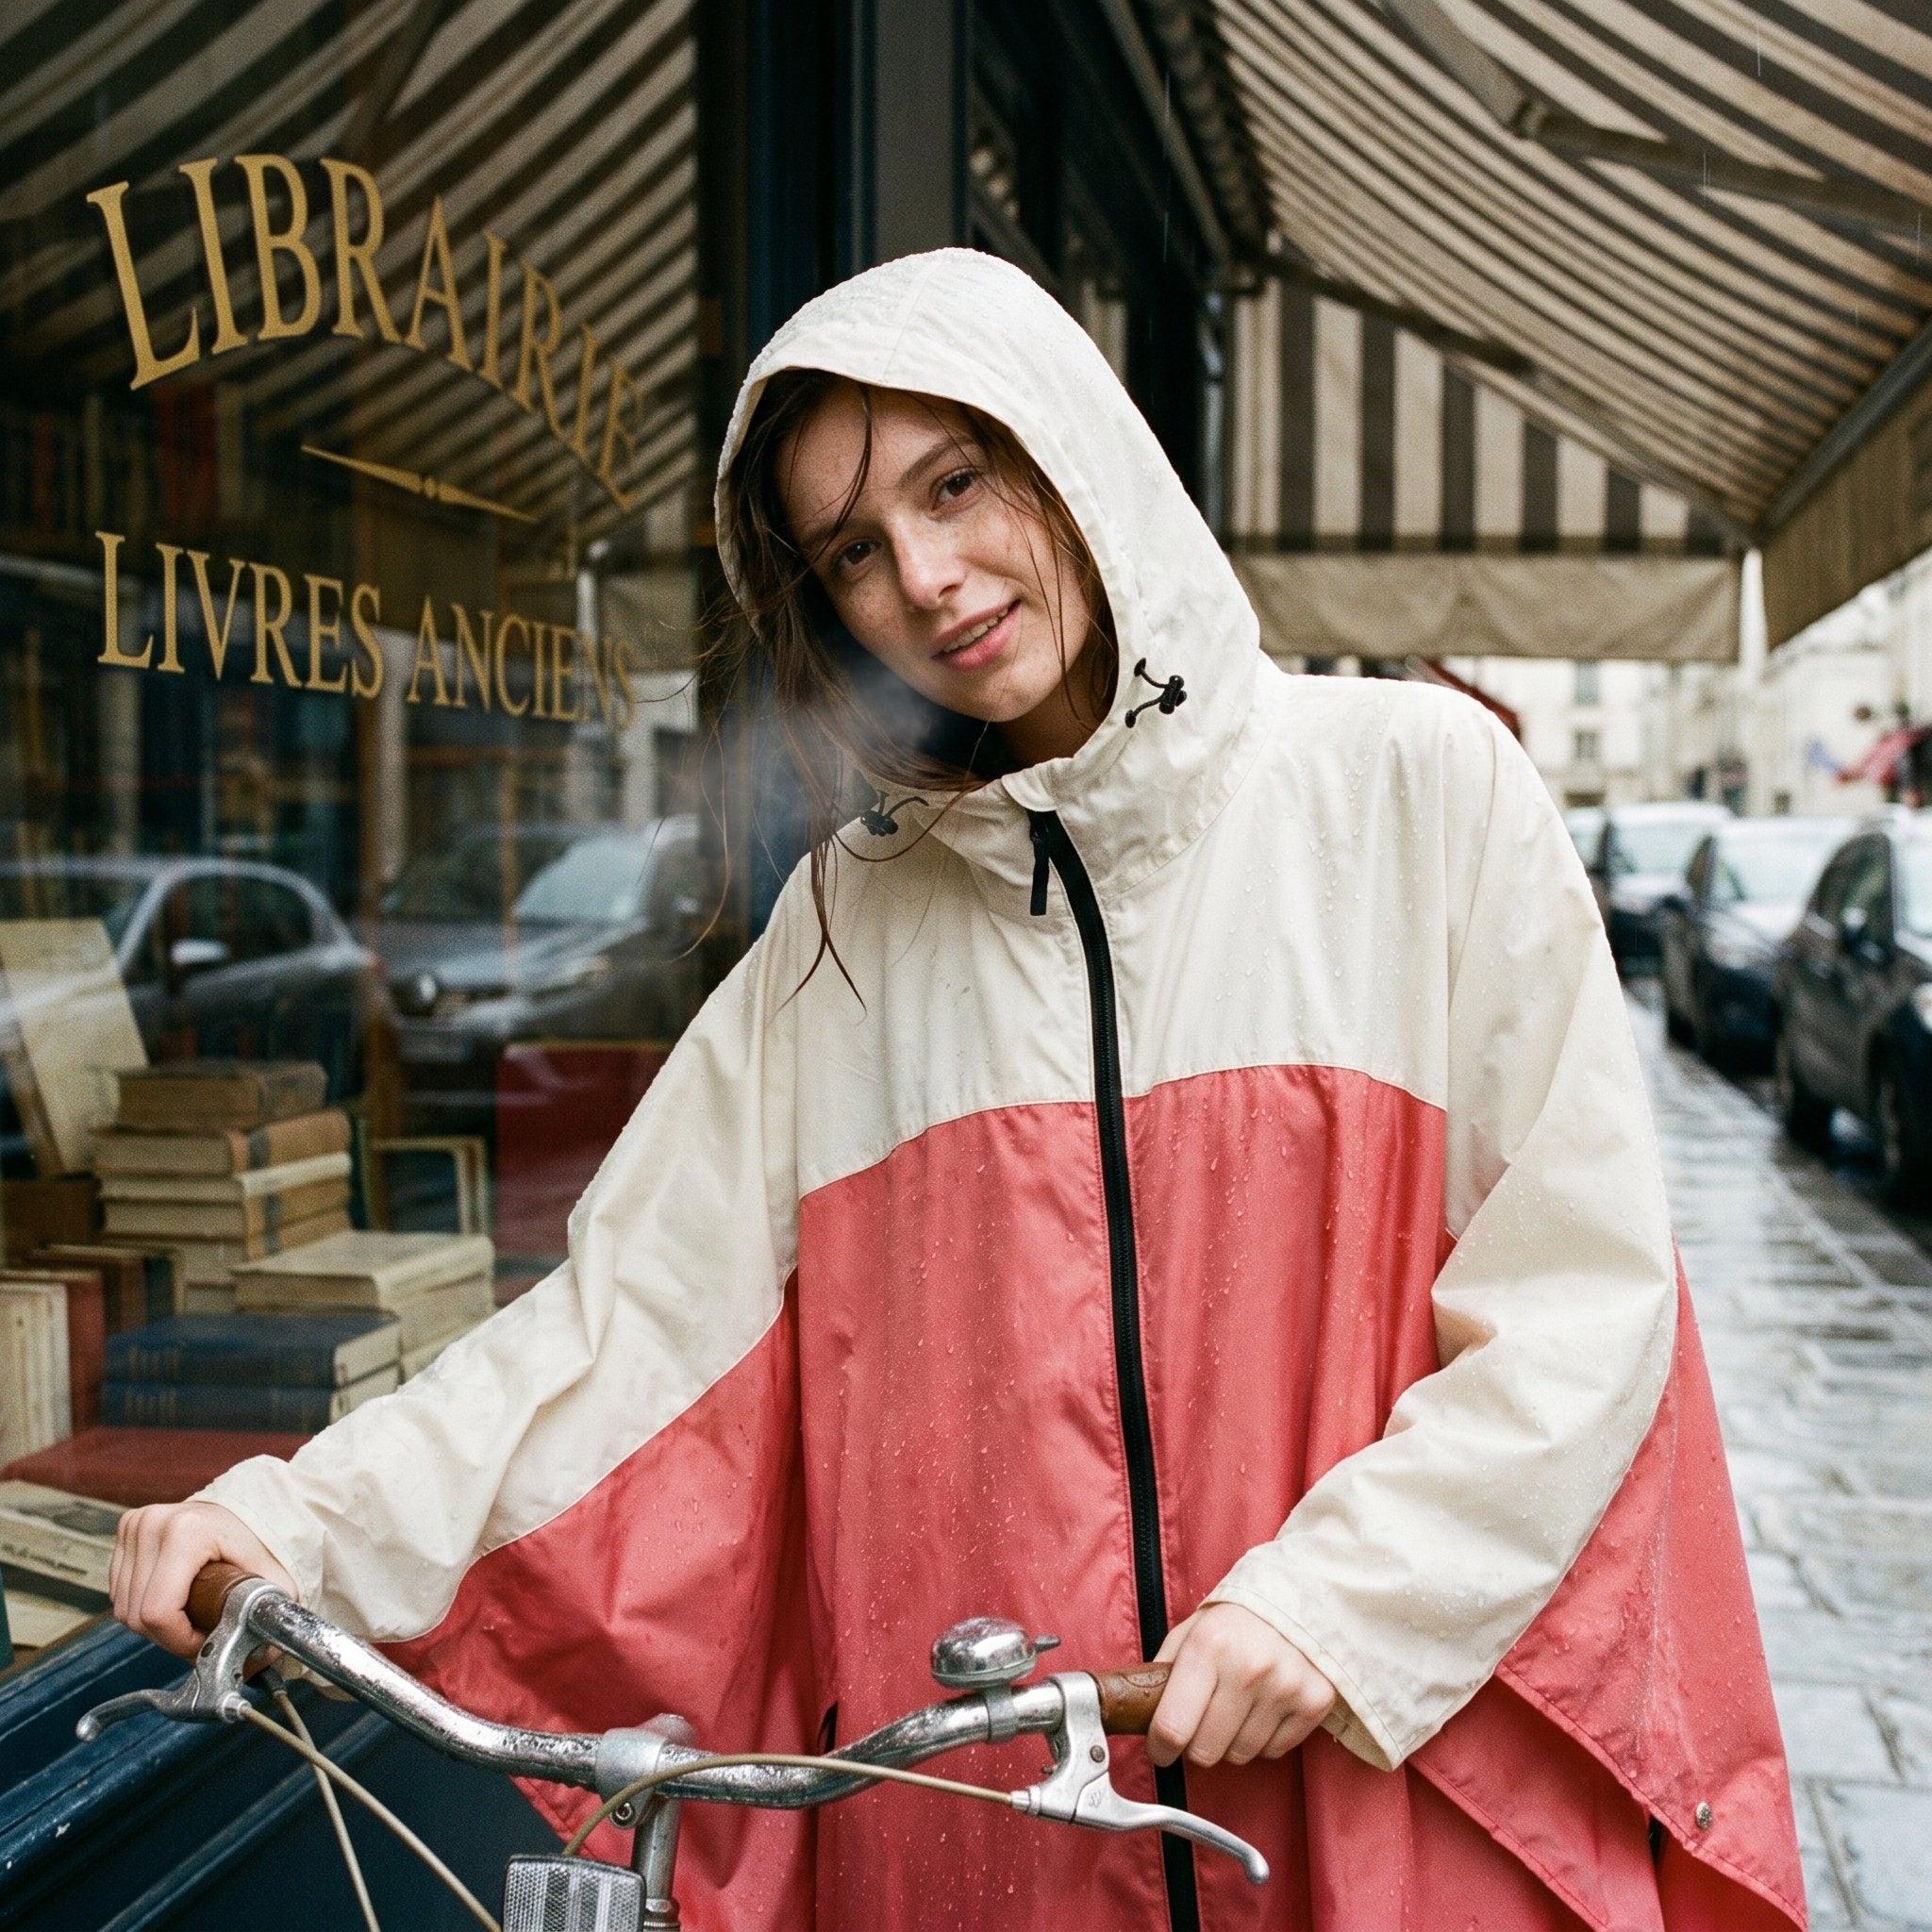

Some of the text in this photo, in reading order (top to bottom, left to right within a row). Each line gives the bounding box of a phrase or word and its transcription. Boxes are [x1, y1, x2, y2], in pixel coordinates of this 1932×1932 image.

[87, 154, 644, 513] LIBRAIRIE
[95, 530, 638, 730] LIVRES ANCIENS
